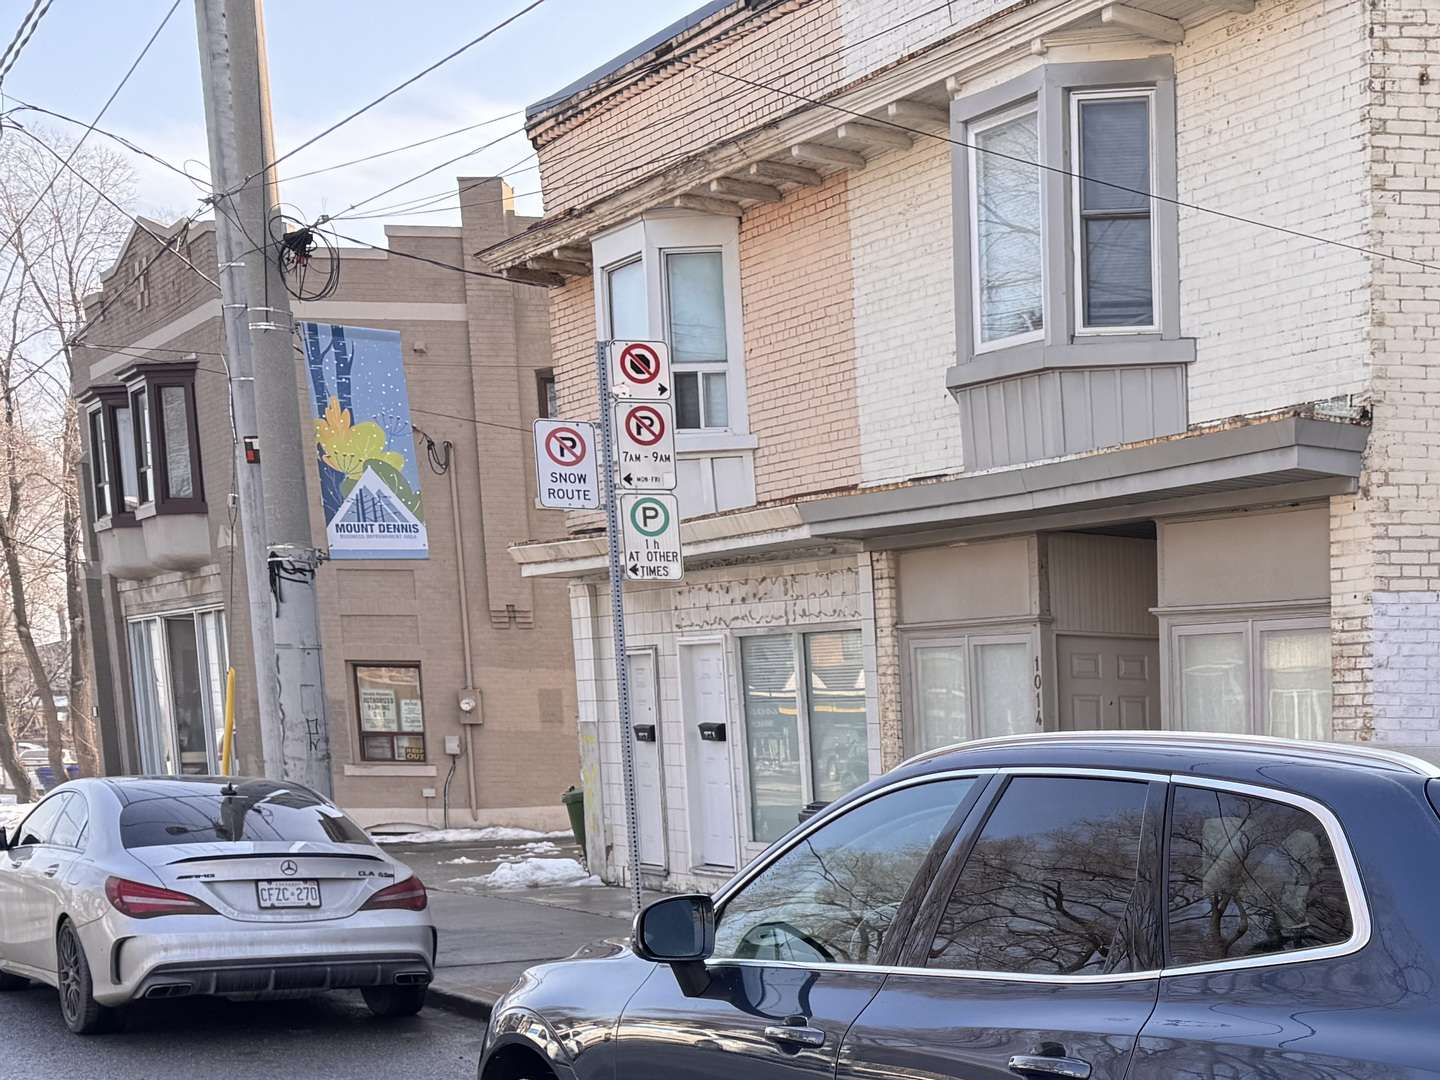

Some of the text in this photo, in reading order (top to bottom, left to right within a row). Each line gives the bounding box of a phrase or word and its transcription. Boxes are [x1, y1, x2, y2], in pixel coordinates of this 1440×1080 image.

[550, 472, 587, 484] SNOW
[547, 488, 591, 501] ROUTE
[335, 523, 420, 534] MOUNT DENNIS
[629, 551, 679, 562] AT OTHER
[640, 565, 669, 577] TIMES
